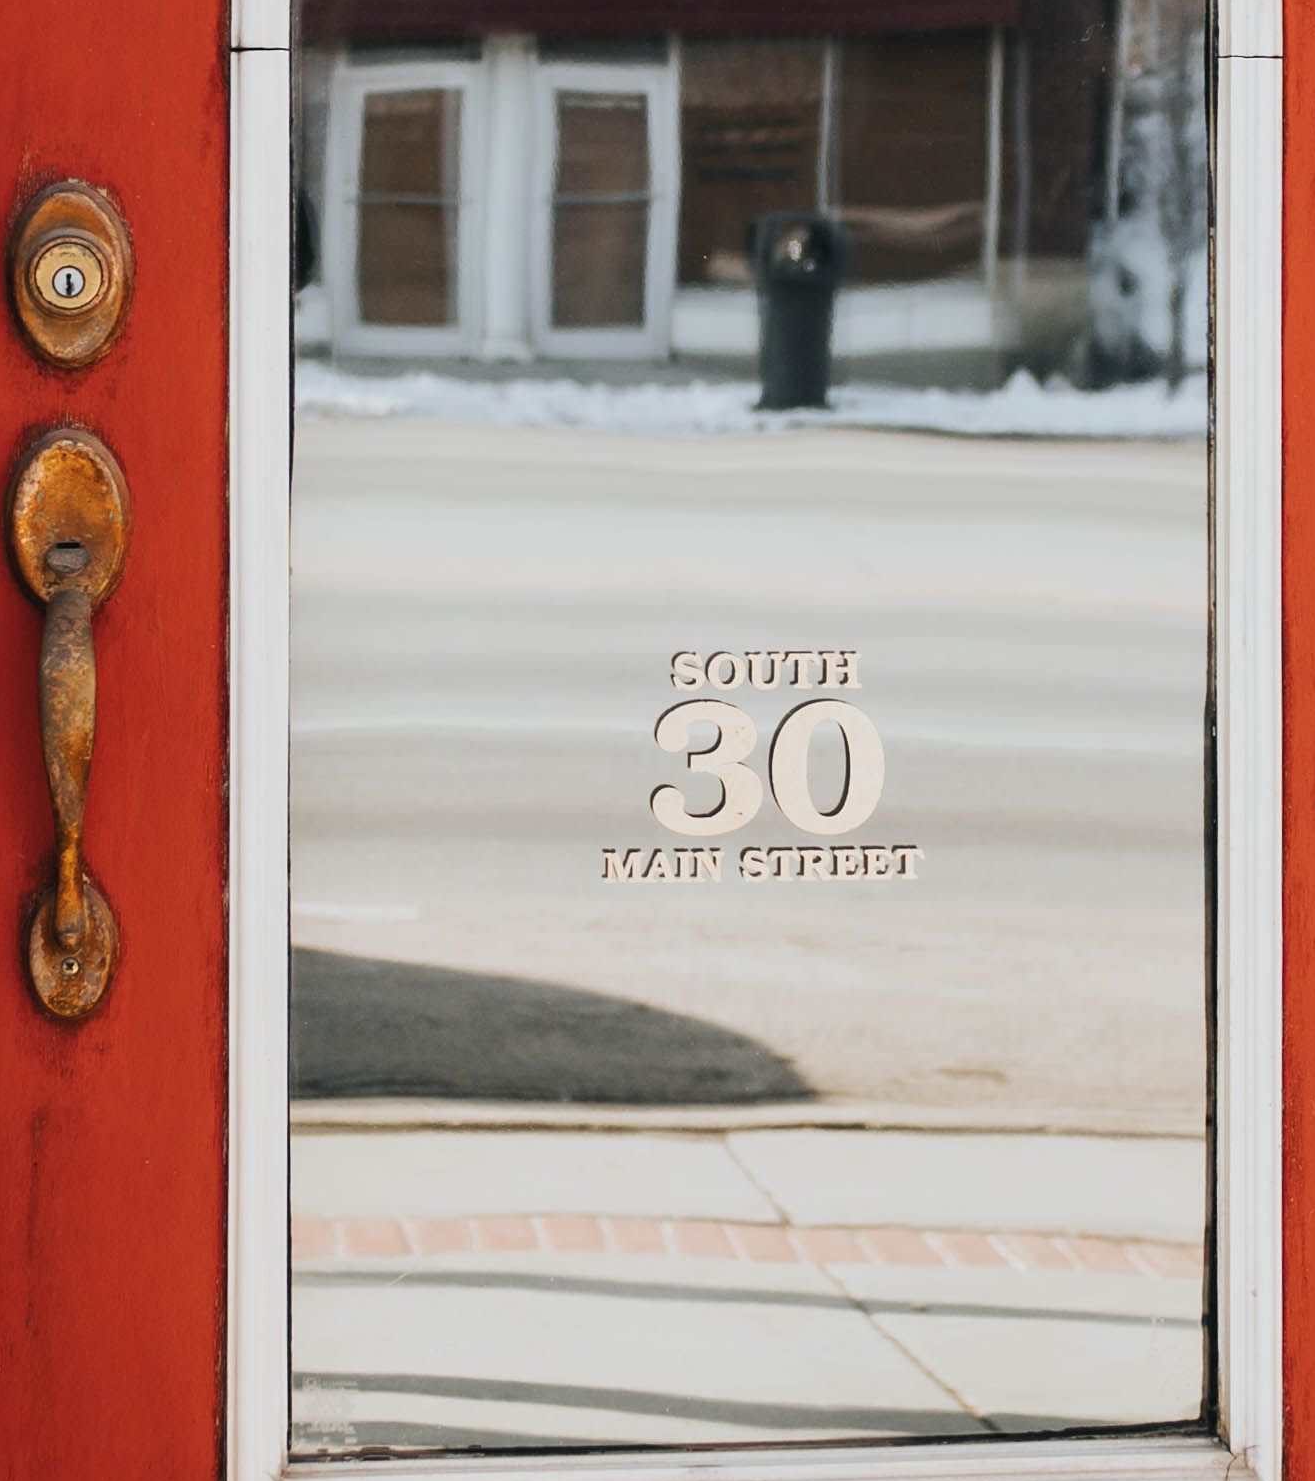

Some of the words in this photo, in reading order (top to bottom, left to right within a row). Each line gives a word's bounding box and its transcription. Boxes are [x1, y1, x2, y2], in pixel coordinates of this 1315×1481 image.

[670, 650, 862, 690] SOUTH
[650, 698, 885, 836] 30
[601, 847, 725, 884] MAIN
[739, 845, 925, 883] STREET
